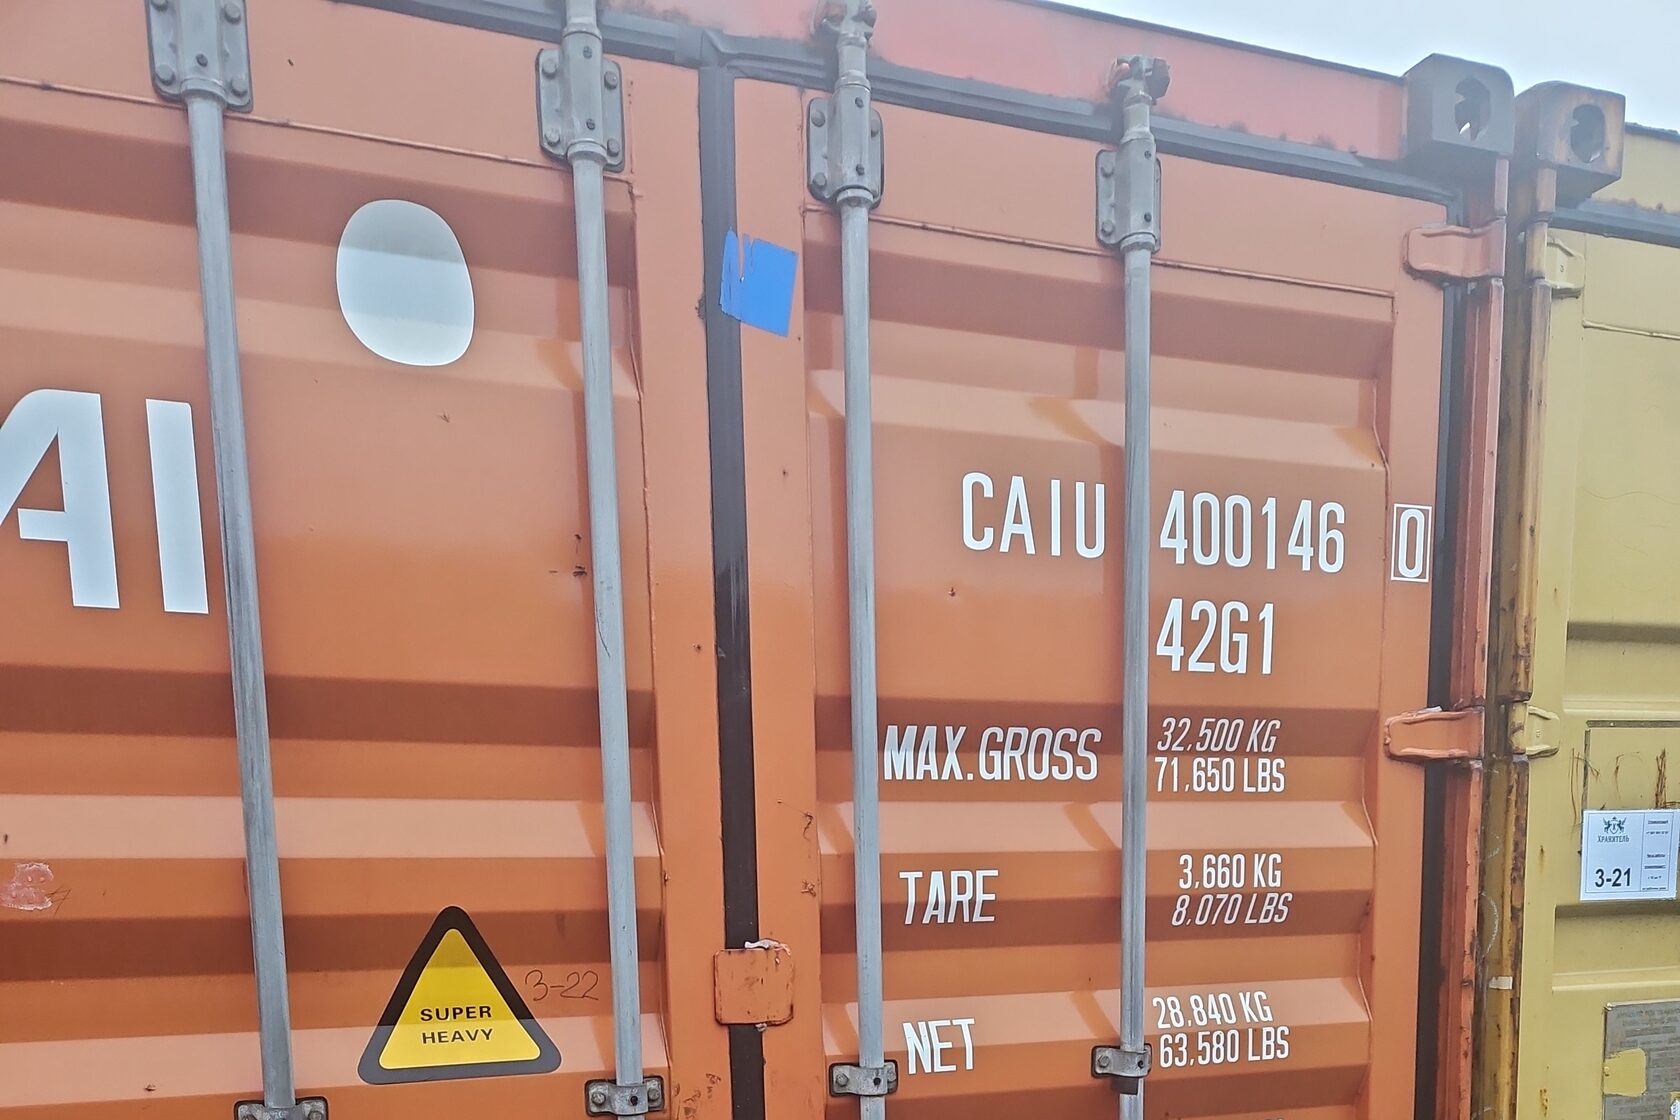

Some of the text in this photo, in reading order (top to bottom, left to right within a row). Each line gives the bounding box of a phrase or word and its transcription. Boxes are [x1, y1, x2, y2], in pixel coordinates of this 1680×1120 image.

[962, 472, 1426, 578] CAIU 400146 0
[1156, 597, 1275, 675] 42G1
[883, 724, 1102, 781] MAX.GROSS
[1245, 718, 1281, 753] KG
[1243, 757, 1286, 793] LBS
[899, 868, 999, 926] TARE
[1253, 853, 1282, 888] KG
[1594, 867, 1632, 888] 3-21
[1244, 892, 1293, 924] LBS
[524, 968, 600, 1001] 3-22
[420, 1004, 493, 1021] SUPER
[421, 1027, 494, 1045] HEAVY
[902, 1017, 976, 1075] NET
[1238, 991, 1273, 1024] KG
[1247, 1026, 1289, 1061] LBS
